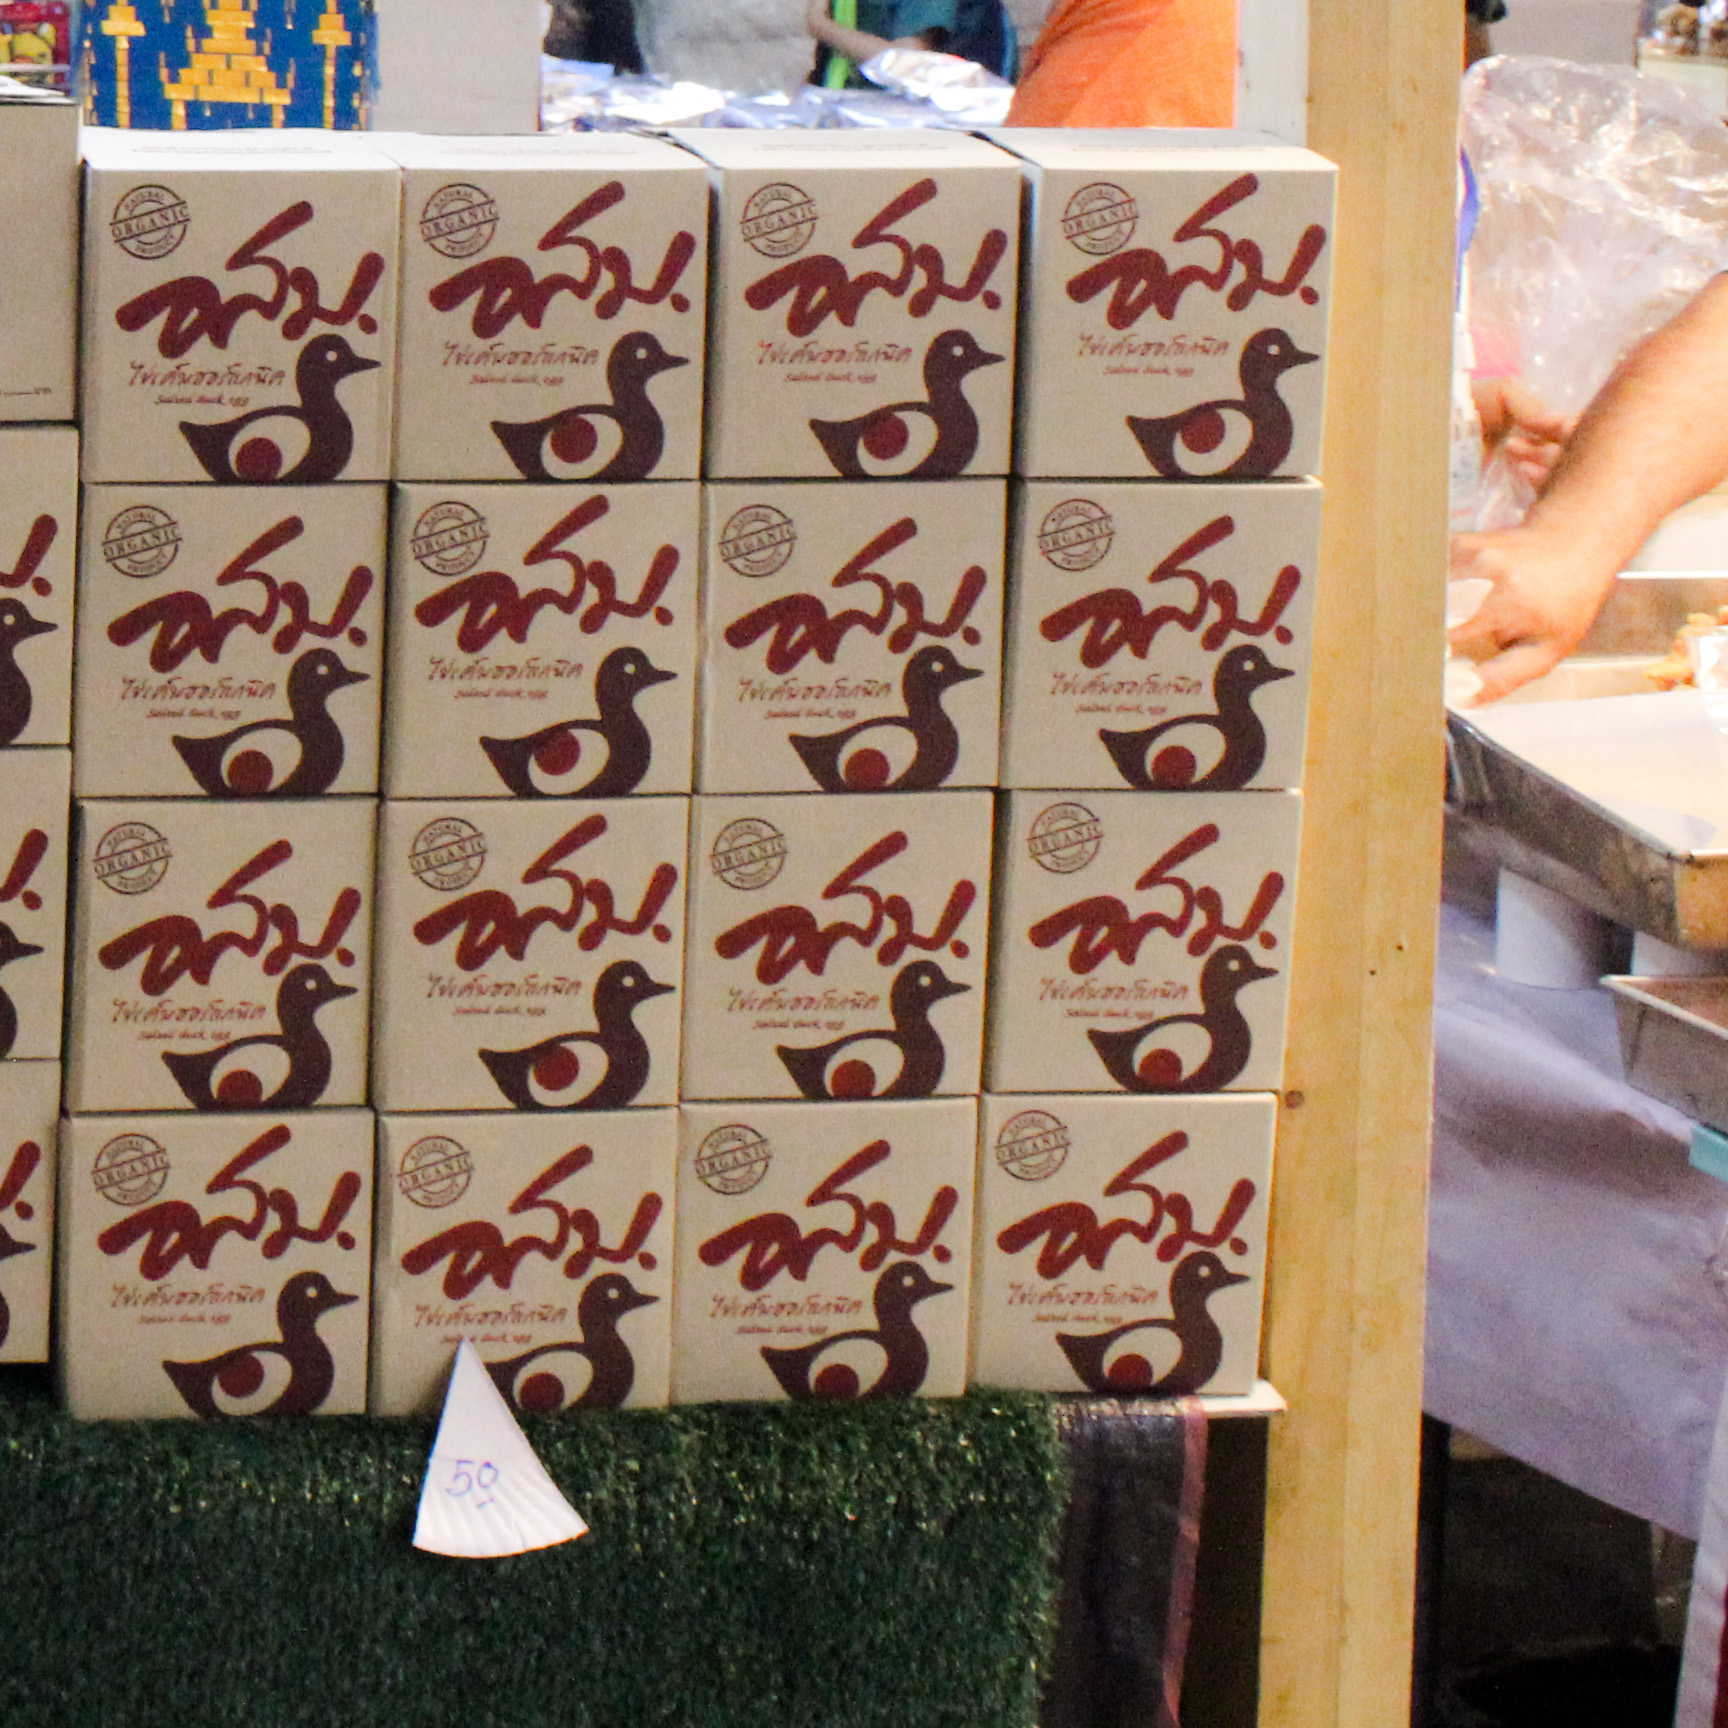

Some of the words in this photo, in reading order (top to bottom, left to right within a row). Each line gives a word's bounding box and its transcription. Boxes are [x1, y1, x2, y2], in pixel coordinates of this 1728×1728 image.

[112, 205, 190, 238] ORGANIC
[420, 204, 498, 237] ORGANIC
[740, 203, 818, 236] ORGANIC
[1061, 202, 1139, 235] ORGANIC
[103, 524, 181, 557] ORGANIC
[411, 521, 489, 554] ORGANIC
[719, 524, 797, 557] ORGANIC
[1037, 518, 1115, 551] ORGANIC
[409, 837, 487, 870] ORGANIC
[710, 837, 788, 870] ORGANIC
[1026, 821, 1104, 854] ORGANIC
[94, 841, 172, 874] ORGANIC
[694, 1142, 772, 1175] ORGANIC
[994, 1128, 1072, 1161] ORGANIC
[93, 1153, 171, 1186] ORGANIC
[397, 1155, 475, 1188] ORGANIC
[445, 1460, 499, 1497] 50
